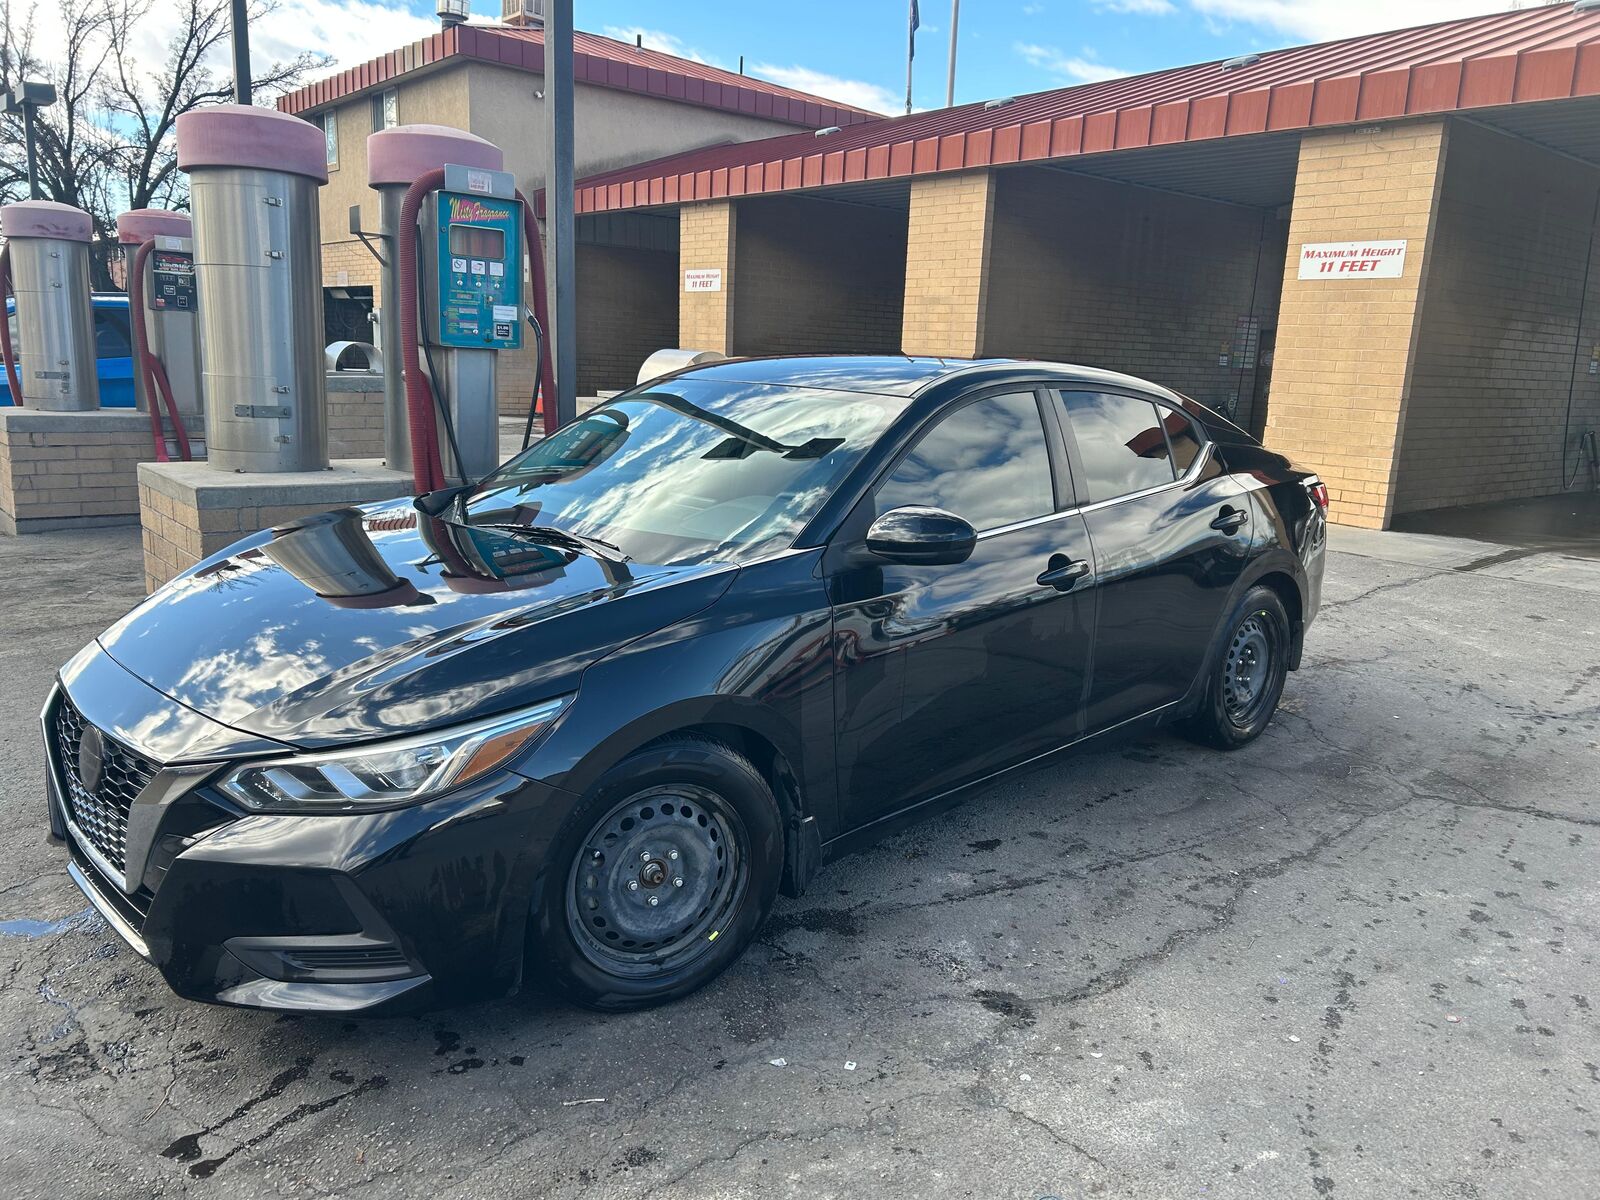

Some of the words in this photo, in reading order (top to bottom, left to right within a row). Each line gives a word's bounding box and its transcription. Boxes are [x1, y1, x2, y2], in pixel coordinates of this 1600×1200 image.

[449, 197, 473, 222] Misty
[473, 202, 510, 222] Fragrance
[1303, 250, 1358, 259] MAXIMUM
[1361, 248, 1404, 257] HEIGHT
[1320, 261, 1335, 273] 11
[1339, 260, 1381, 272] FEET
